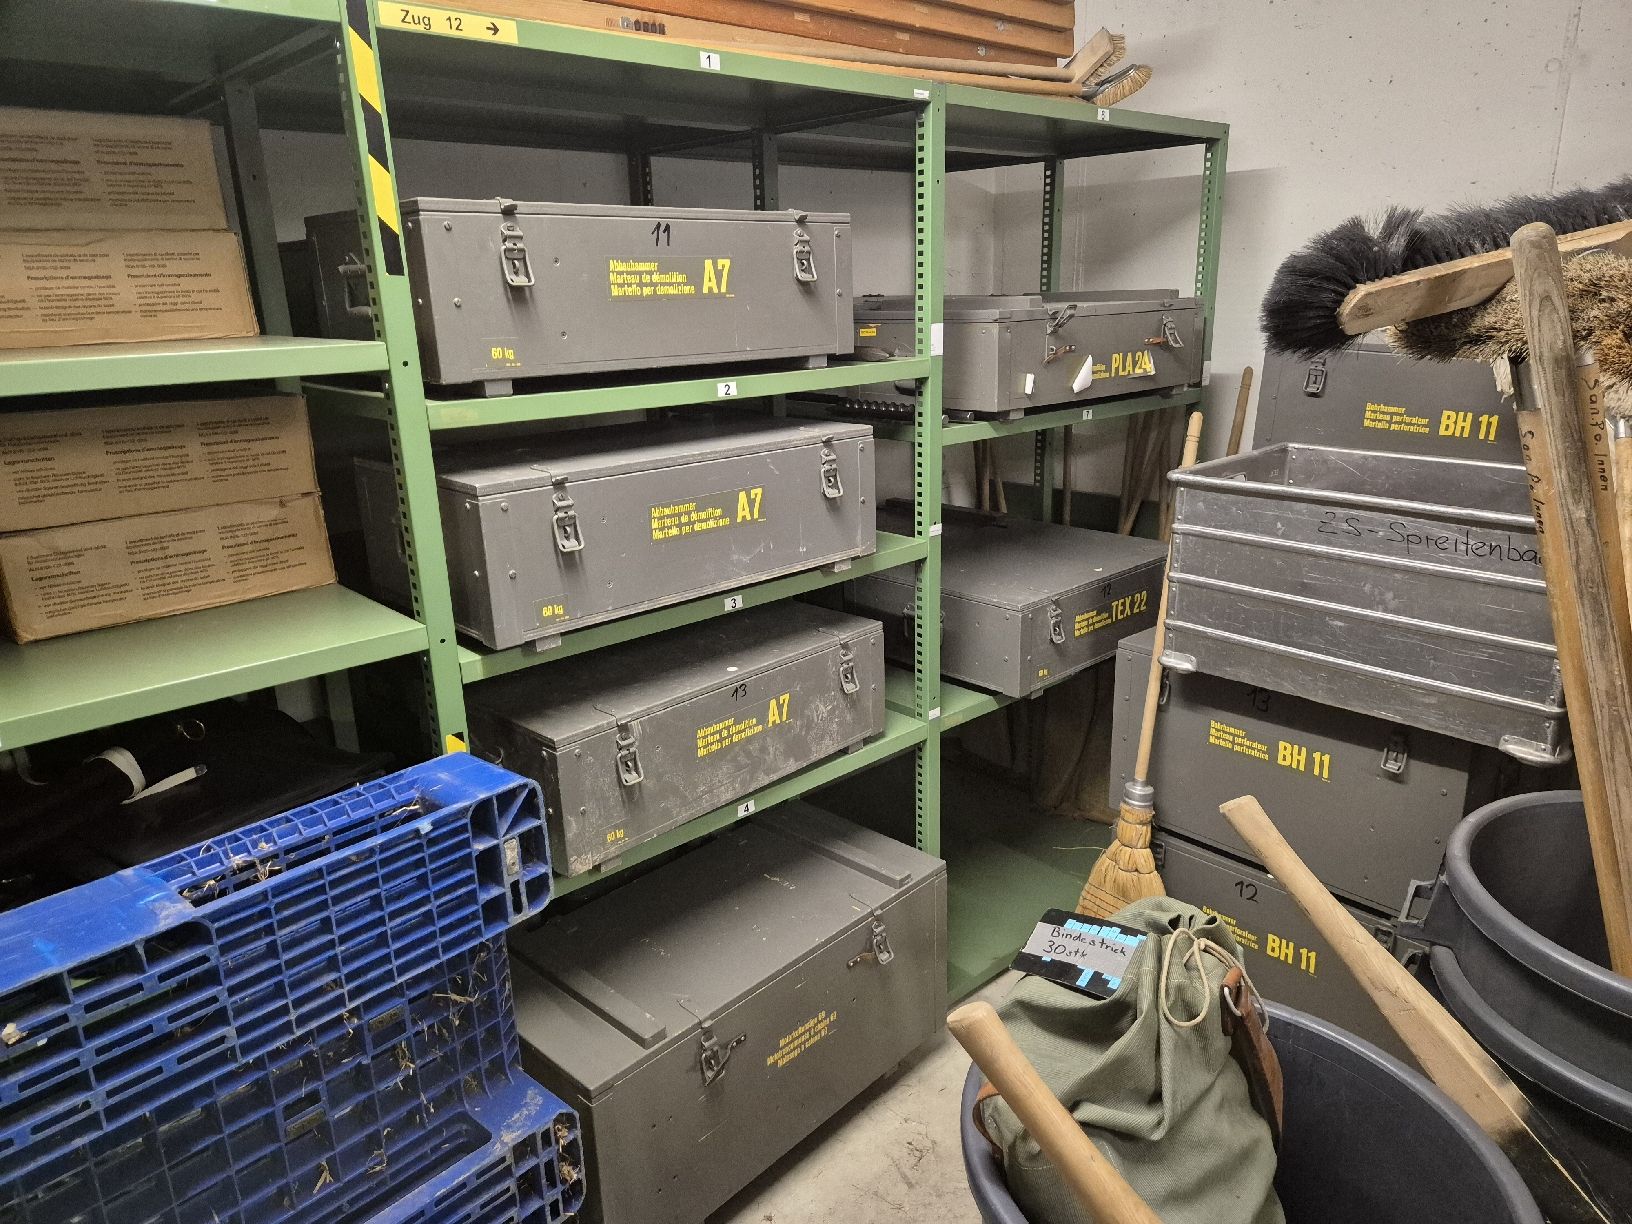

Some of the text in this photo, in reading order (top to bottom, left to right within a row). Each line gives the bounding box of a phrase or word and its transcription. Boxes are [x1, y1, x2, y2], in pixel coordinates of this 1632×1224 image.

[400, 9, 463, 32] Zug 12
[706, 55, 712, 68] 1
[652, 222, 670, 246] 11
[610, 259, 658, 271] Abbauhammer
[610, 272, 686, 284] Marteau de démolition
[702, 258, 730, 294] A7
[611, 284, 695, 298] Martello per demolizione
[492, 348, 514, 360] 60 kg
[1111, 352, 1134, 377] PLA
[1135, 350, 1152, 374] 24
[724, 384, 730, 396] 2
[1366, 402, 1406, 413] Bohrhammer
[1364, 410, 1430, 425] Marteau perforateur
[1364, 418, 1389, 429] Martello
[1438, 410, 1498, 441] BH 11
[652, 502, 696, 518] Abbauhammer
[737, 488, 762, 522] A7
[652, 507, 722, 529] Marteau de démolition
[652, 517, 730, 540] Martello per demolizione
[543, 604, 564, 617] 60 kg
[731, 598, 737, 608] 3
[1112, 590, 1148, 622] TEX 22
[731, 684, 747, 700] 13
[768, 692, 790, 728] A7
[1210, 720, 1246, 737] Bohrhammer
[1209, 735, 1269, 760] Martello perforatrice
[1210, 727, 1268, 752] Marteau perforateur
[1278, 740, 1330, 779] BH 11
[744, 804, 750, 813] 4
[607, 829, 624, 842] 60 kg
[1234, 880, 1260, 904] 12
[1266, 933, 1316, 974] BH 11
